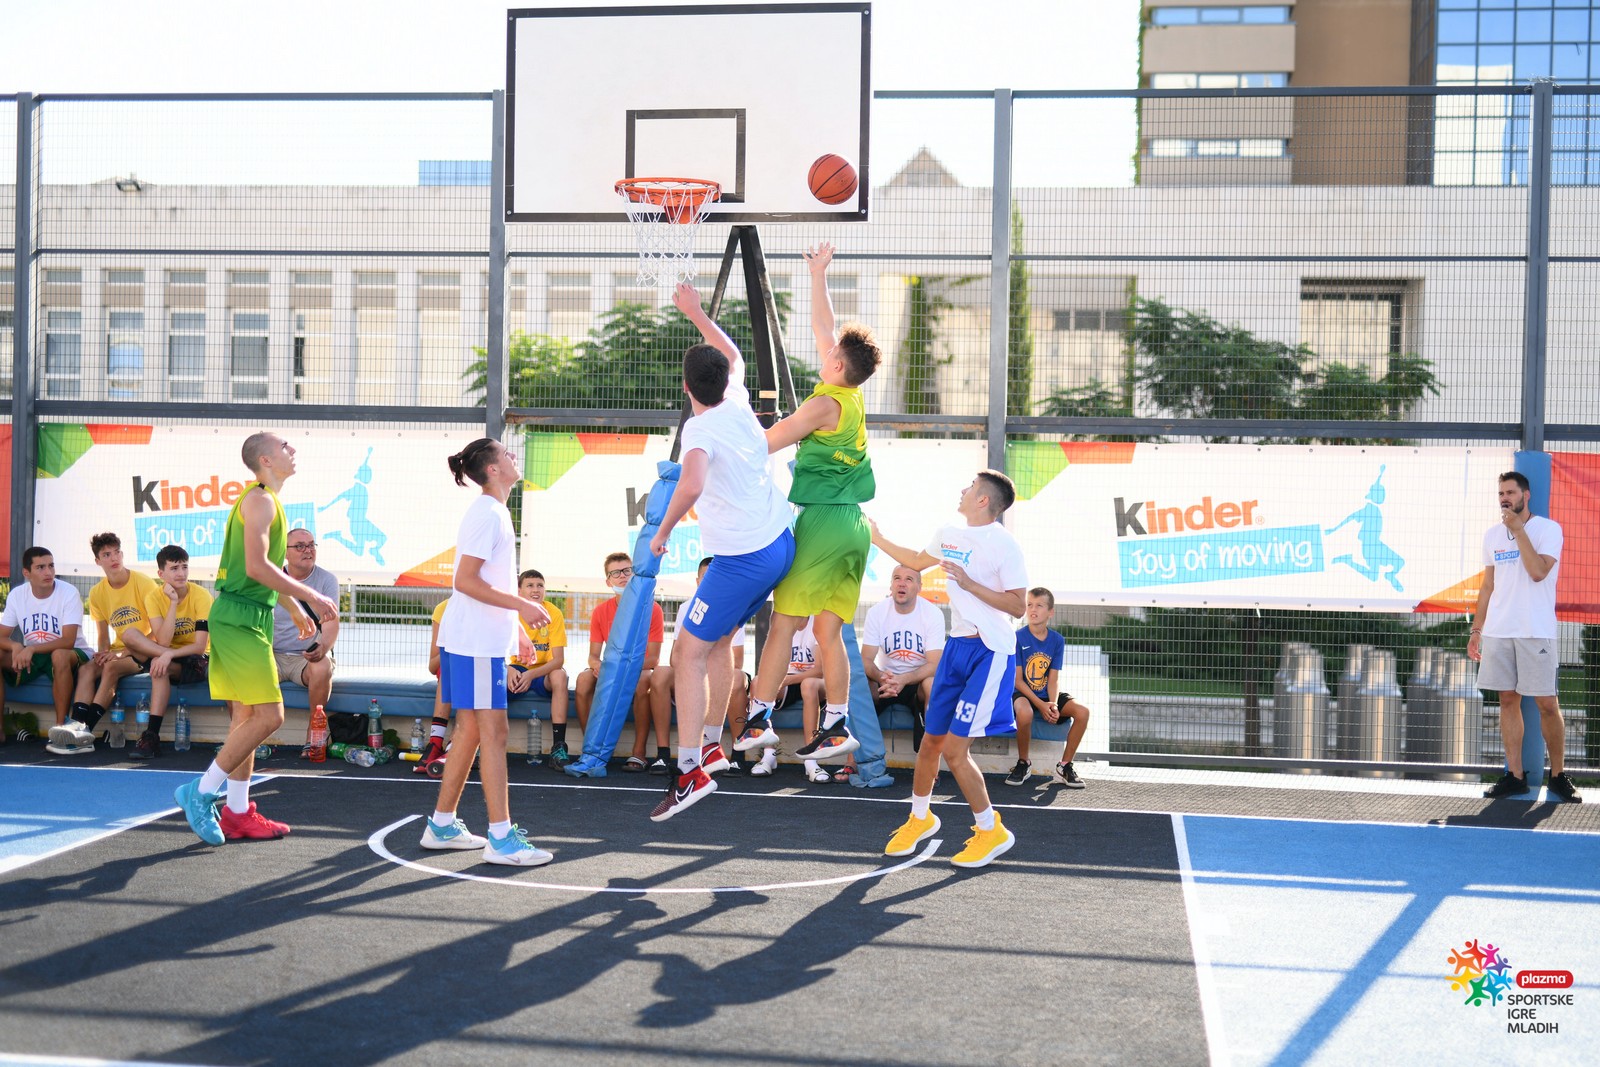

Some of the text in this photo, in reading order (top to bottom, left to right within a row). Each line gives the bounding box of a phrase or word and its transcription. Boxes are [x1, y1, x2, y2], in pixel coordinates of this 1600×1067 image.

[144, 524, 187, 549] Joy
[192, 518, 217, 546] of
[1128, 536, 1313, 579] Joy of moving
[111, 615, 142, 628] BASKETBALL
[688, 597, 710, 626] 15
[23, 613, 60, 636] LEGE
[884, 630, 924, 655] LEGE
[1039, 660, 1049, 669] 30
[955, 699, 977, 723] 43
